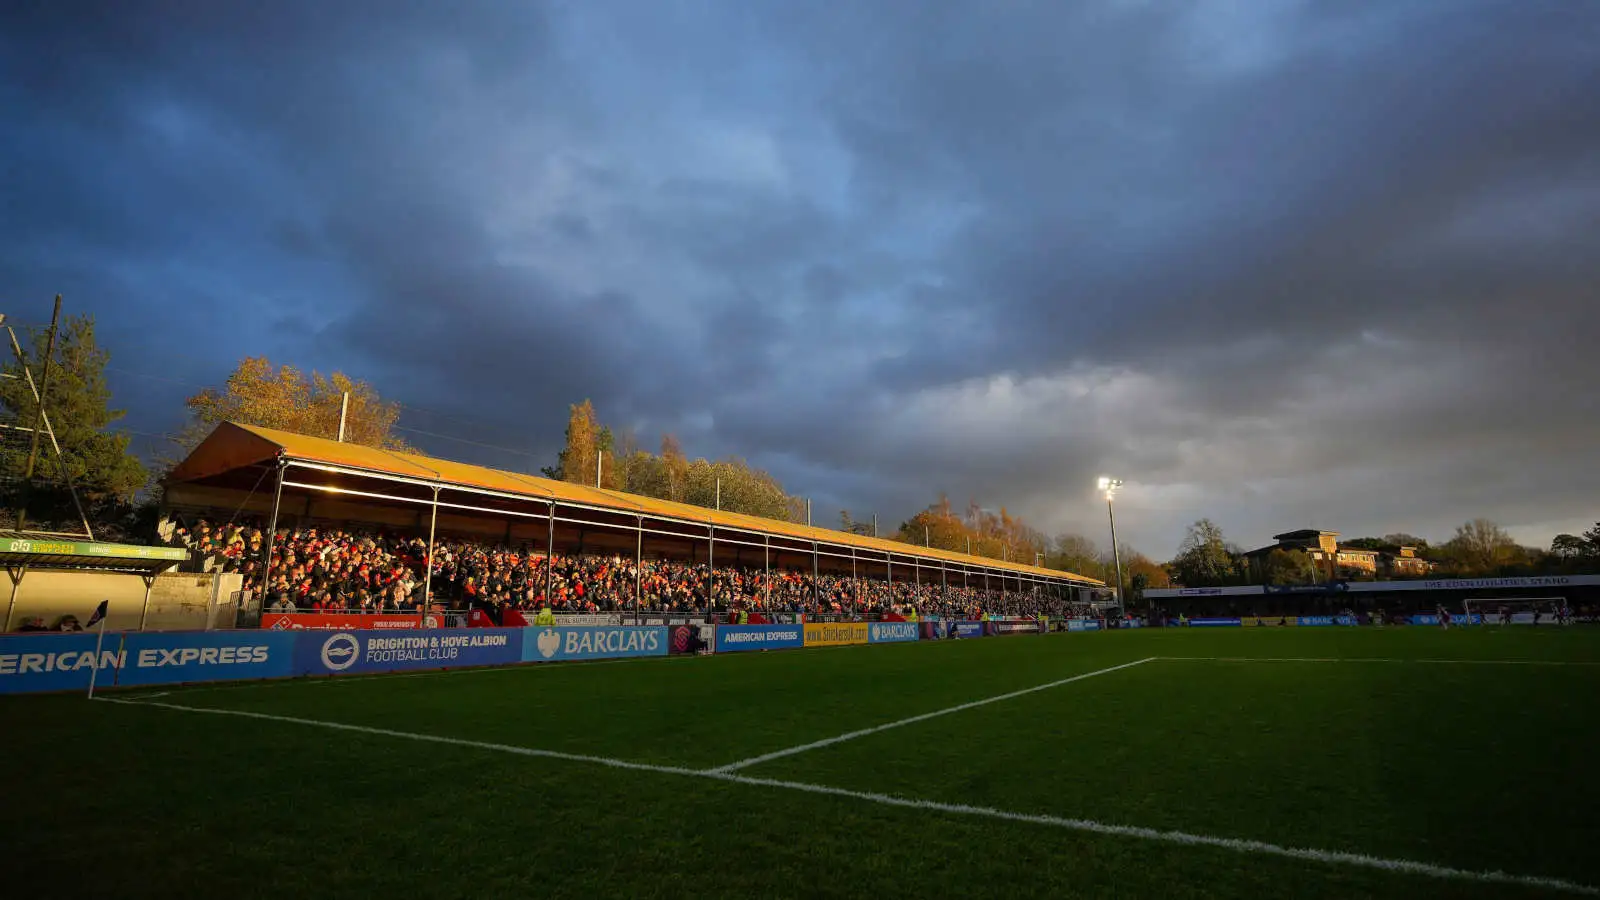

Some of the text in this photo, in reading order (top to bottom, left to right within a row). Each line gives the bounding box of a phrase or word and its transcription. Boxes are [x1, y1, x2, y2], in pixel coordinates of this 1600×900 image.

[1530, 577, 1569, 585] STAND
[724, 631, 798, 643] AMERICAN EXPRESS
[881, 624, 915, 639] BARCLAYS
[367, 635, 507, 650] BRIGHTON & HOVE ALBION
[564, 630, 659, 654] BARCLAYS
[137, 645, 269, 668] EXPRESS
[366, 648, 458, 662] FOOTBALL CLUB
